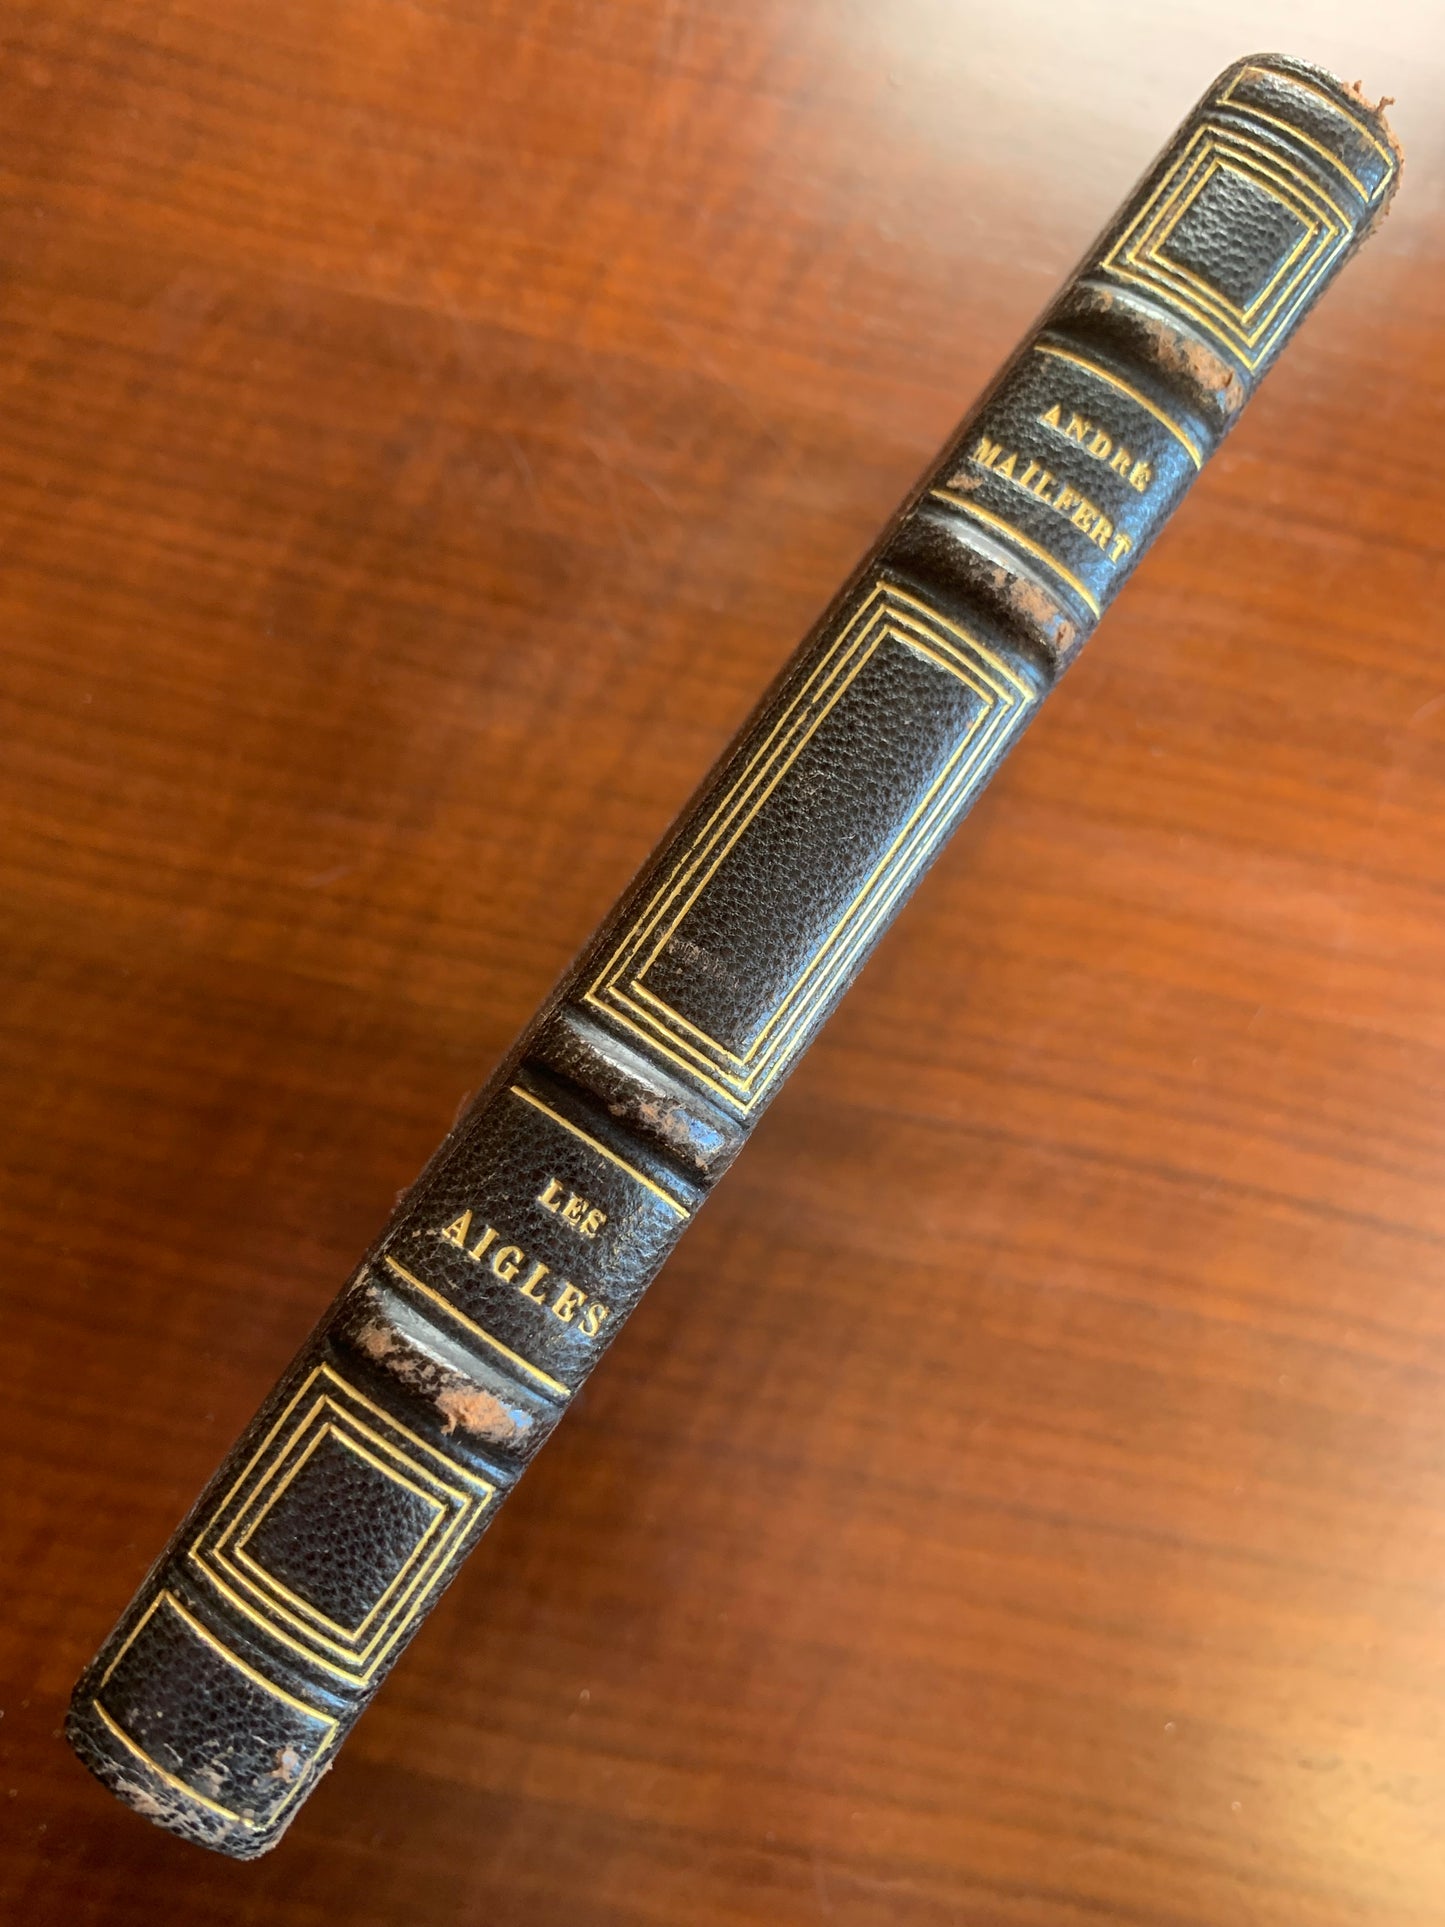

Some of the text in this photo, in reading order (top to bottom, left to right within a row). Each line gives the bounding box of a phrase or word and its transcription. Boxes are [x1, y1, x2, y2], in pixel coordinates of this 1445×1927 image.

[971, 436, 1132, 564] MAILFERT
[538, 1177, 607, 1238] LES
[442, 1209, 609, 1337] AIGLES
